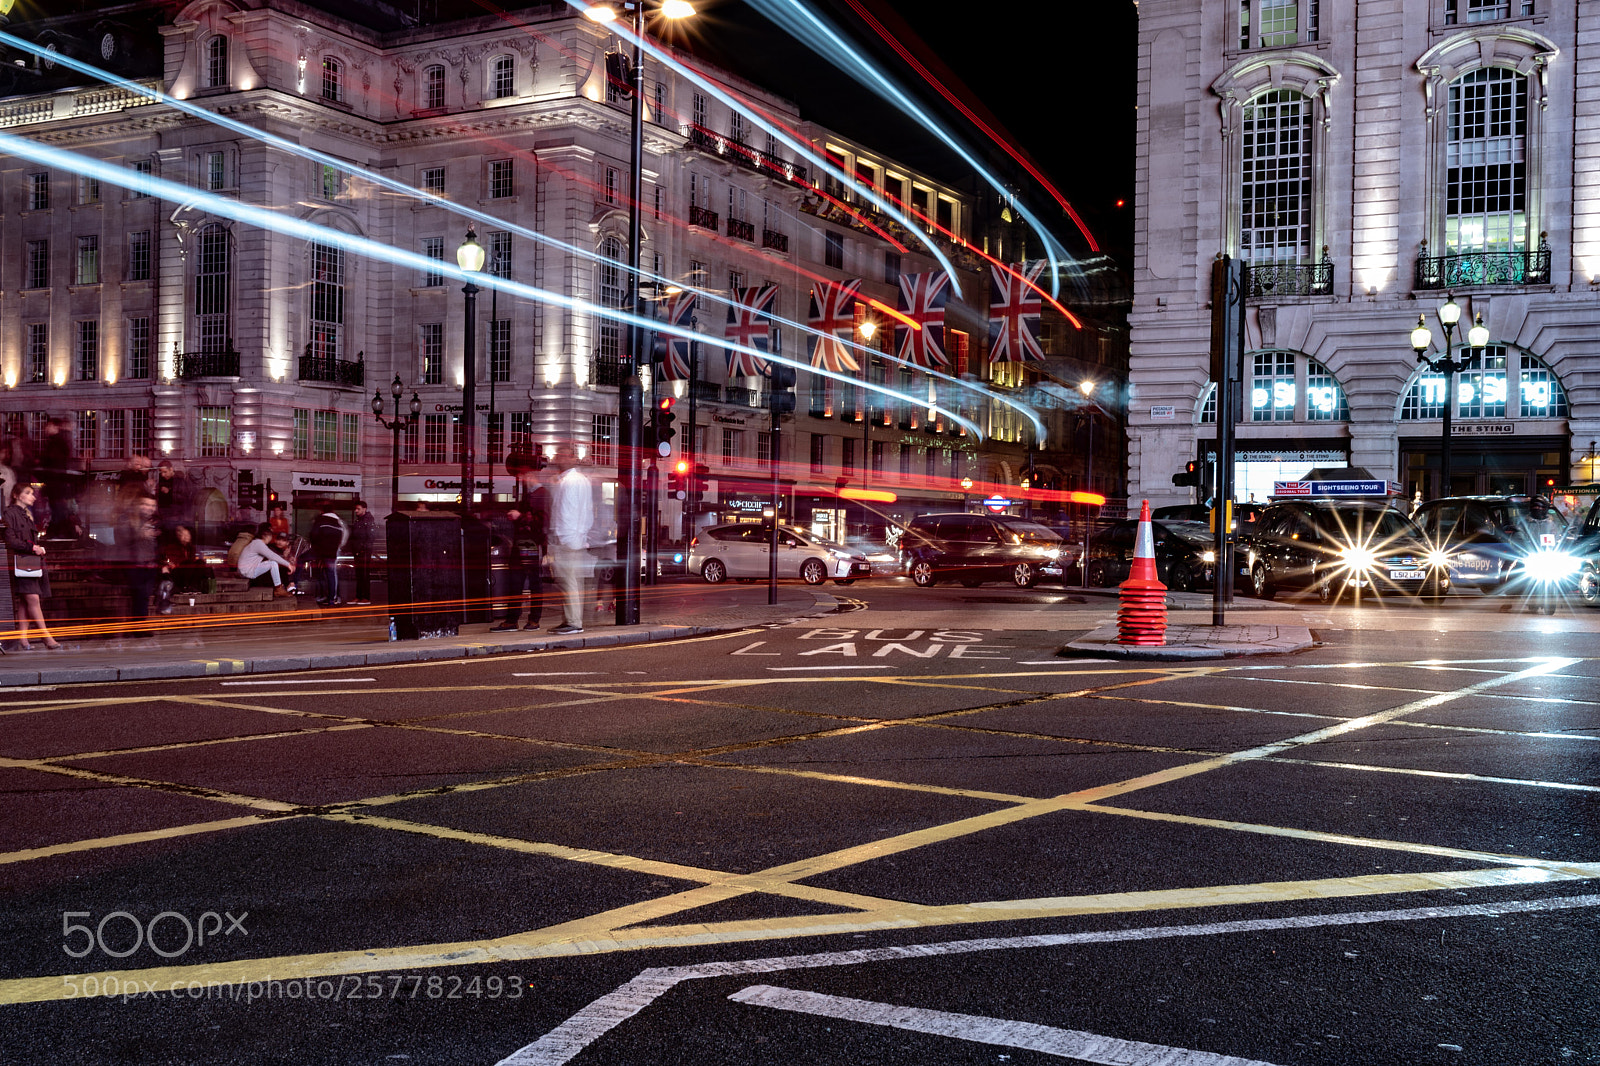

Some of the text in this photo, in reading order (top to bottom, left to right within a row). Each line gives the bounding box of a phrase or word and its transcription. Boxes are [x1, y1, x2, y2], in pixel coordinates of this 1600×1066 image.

[1451, 424, 1512, 433] THE STING
[310, 478, 355, 487] Yorkshire Bank
[797, 628, 983, 643] BUS
[730, 641, 1017, 660] LANE
